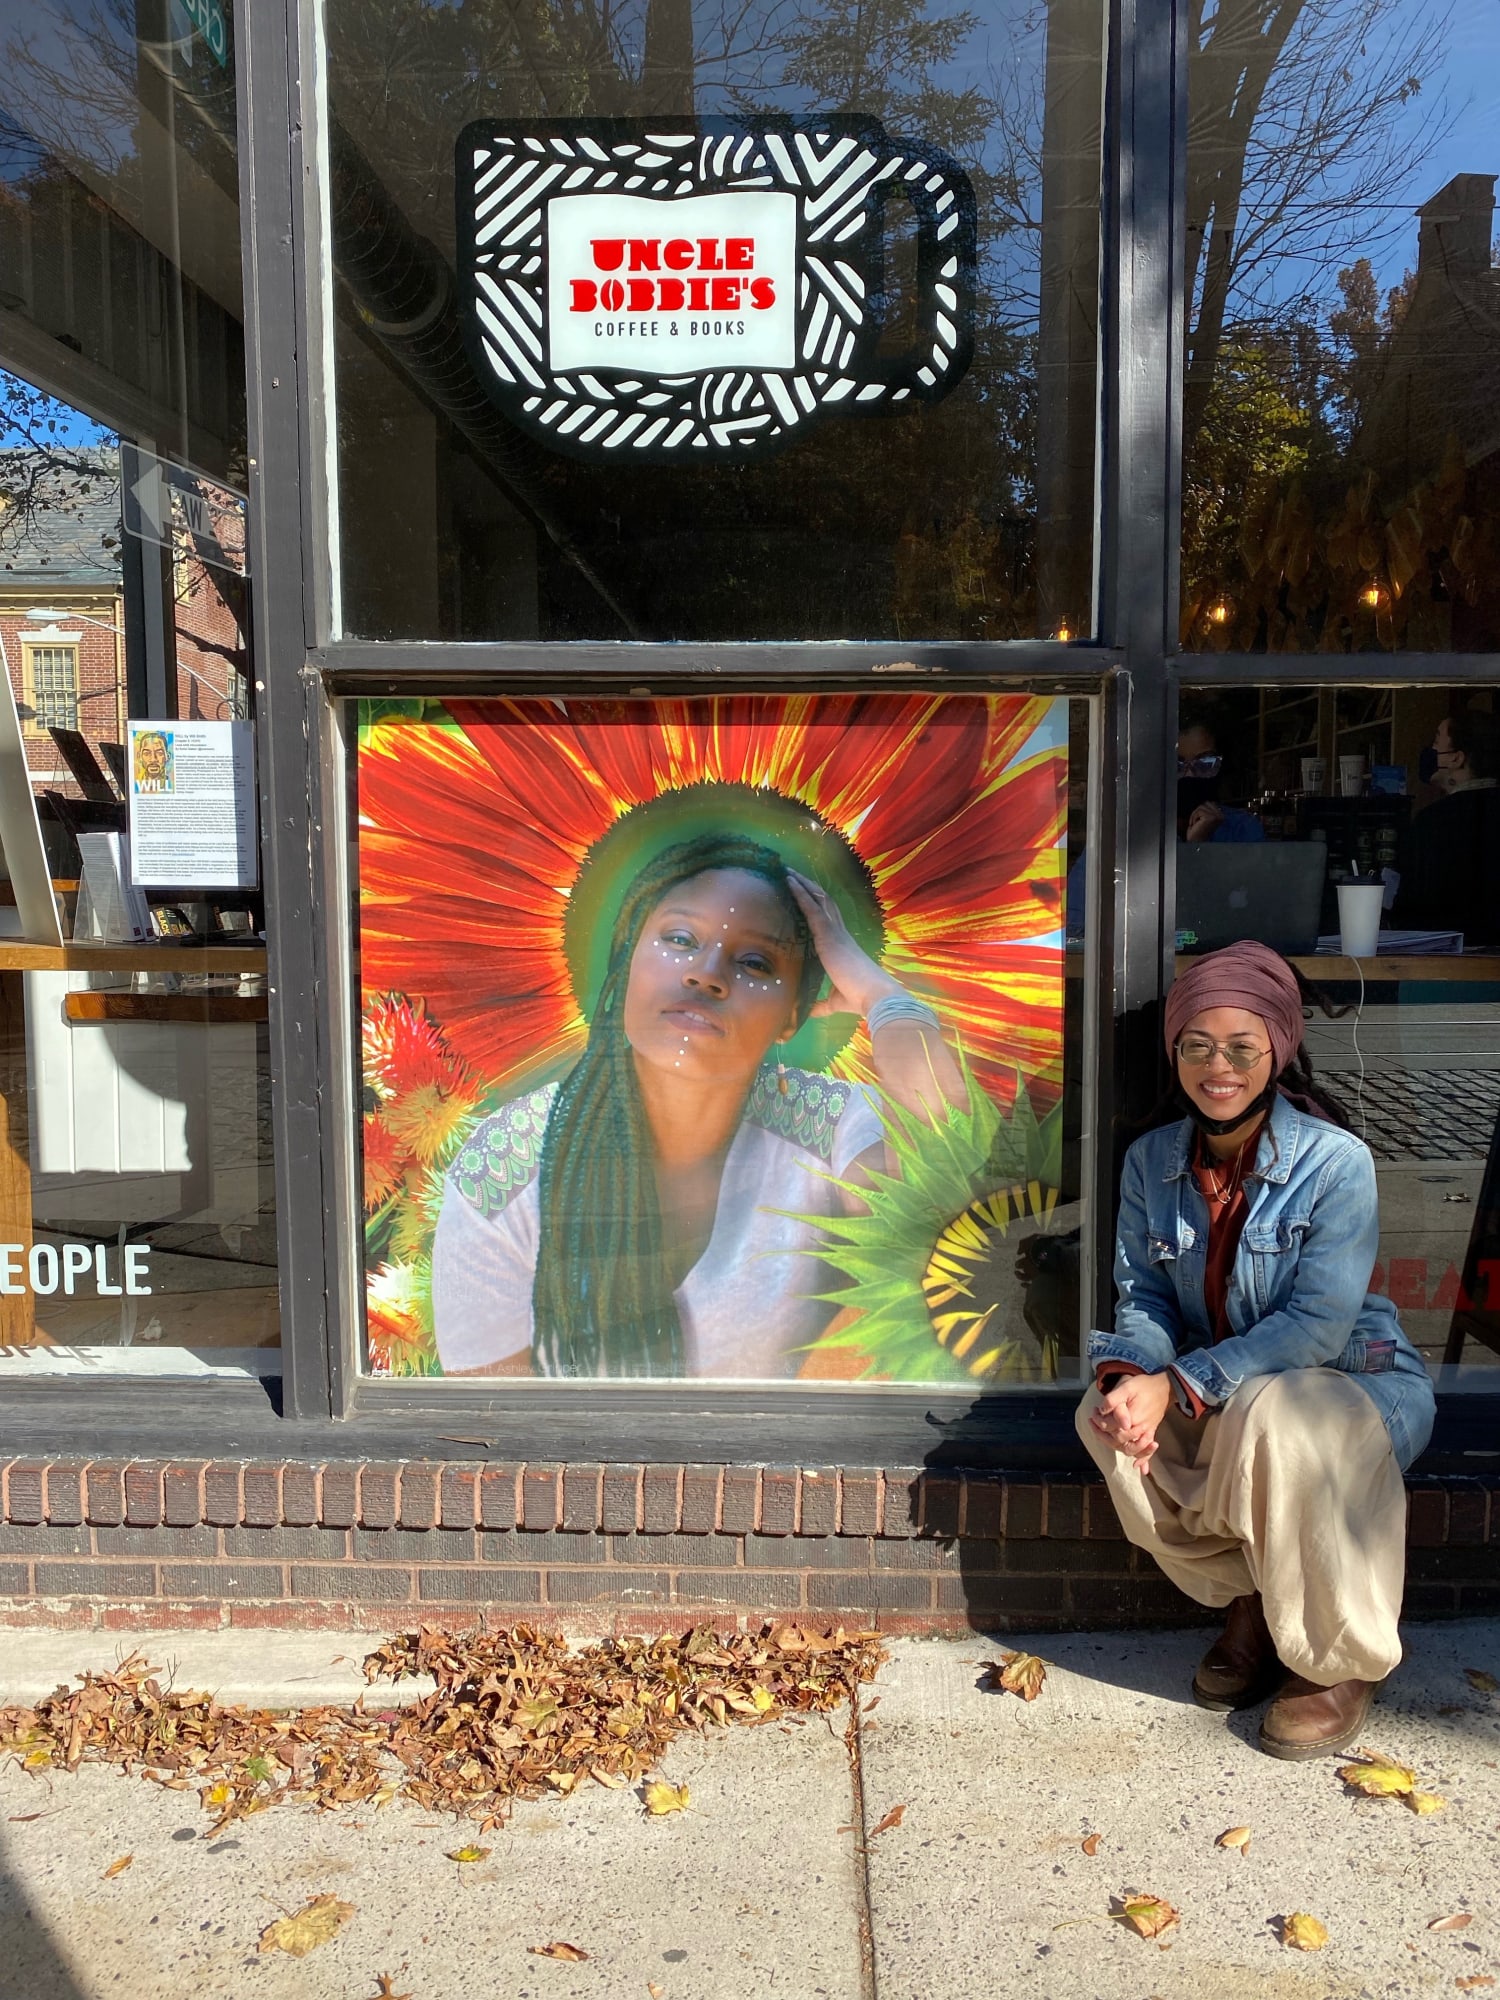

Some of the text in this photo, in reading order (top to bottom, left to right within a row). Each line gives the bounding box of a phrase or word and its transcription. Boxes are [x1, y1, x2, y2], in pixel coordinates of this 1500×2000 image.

[590, 238, 754, 271] UNCLE
[569, 277, 776, 312] BOBBIE'S
[594, 320, 745, 336] COFFEE & BOOKS
[136, 779, 172, 792] WILL
[496, 1363, 535, 1377] Ashley
